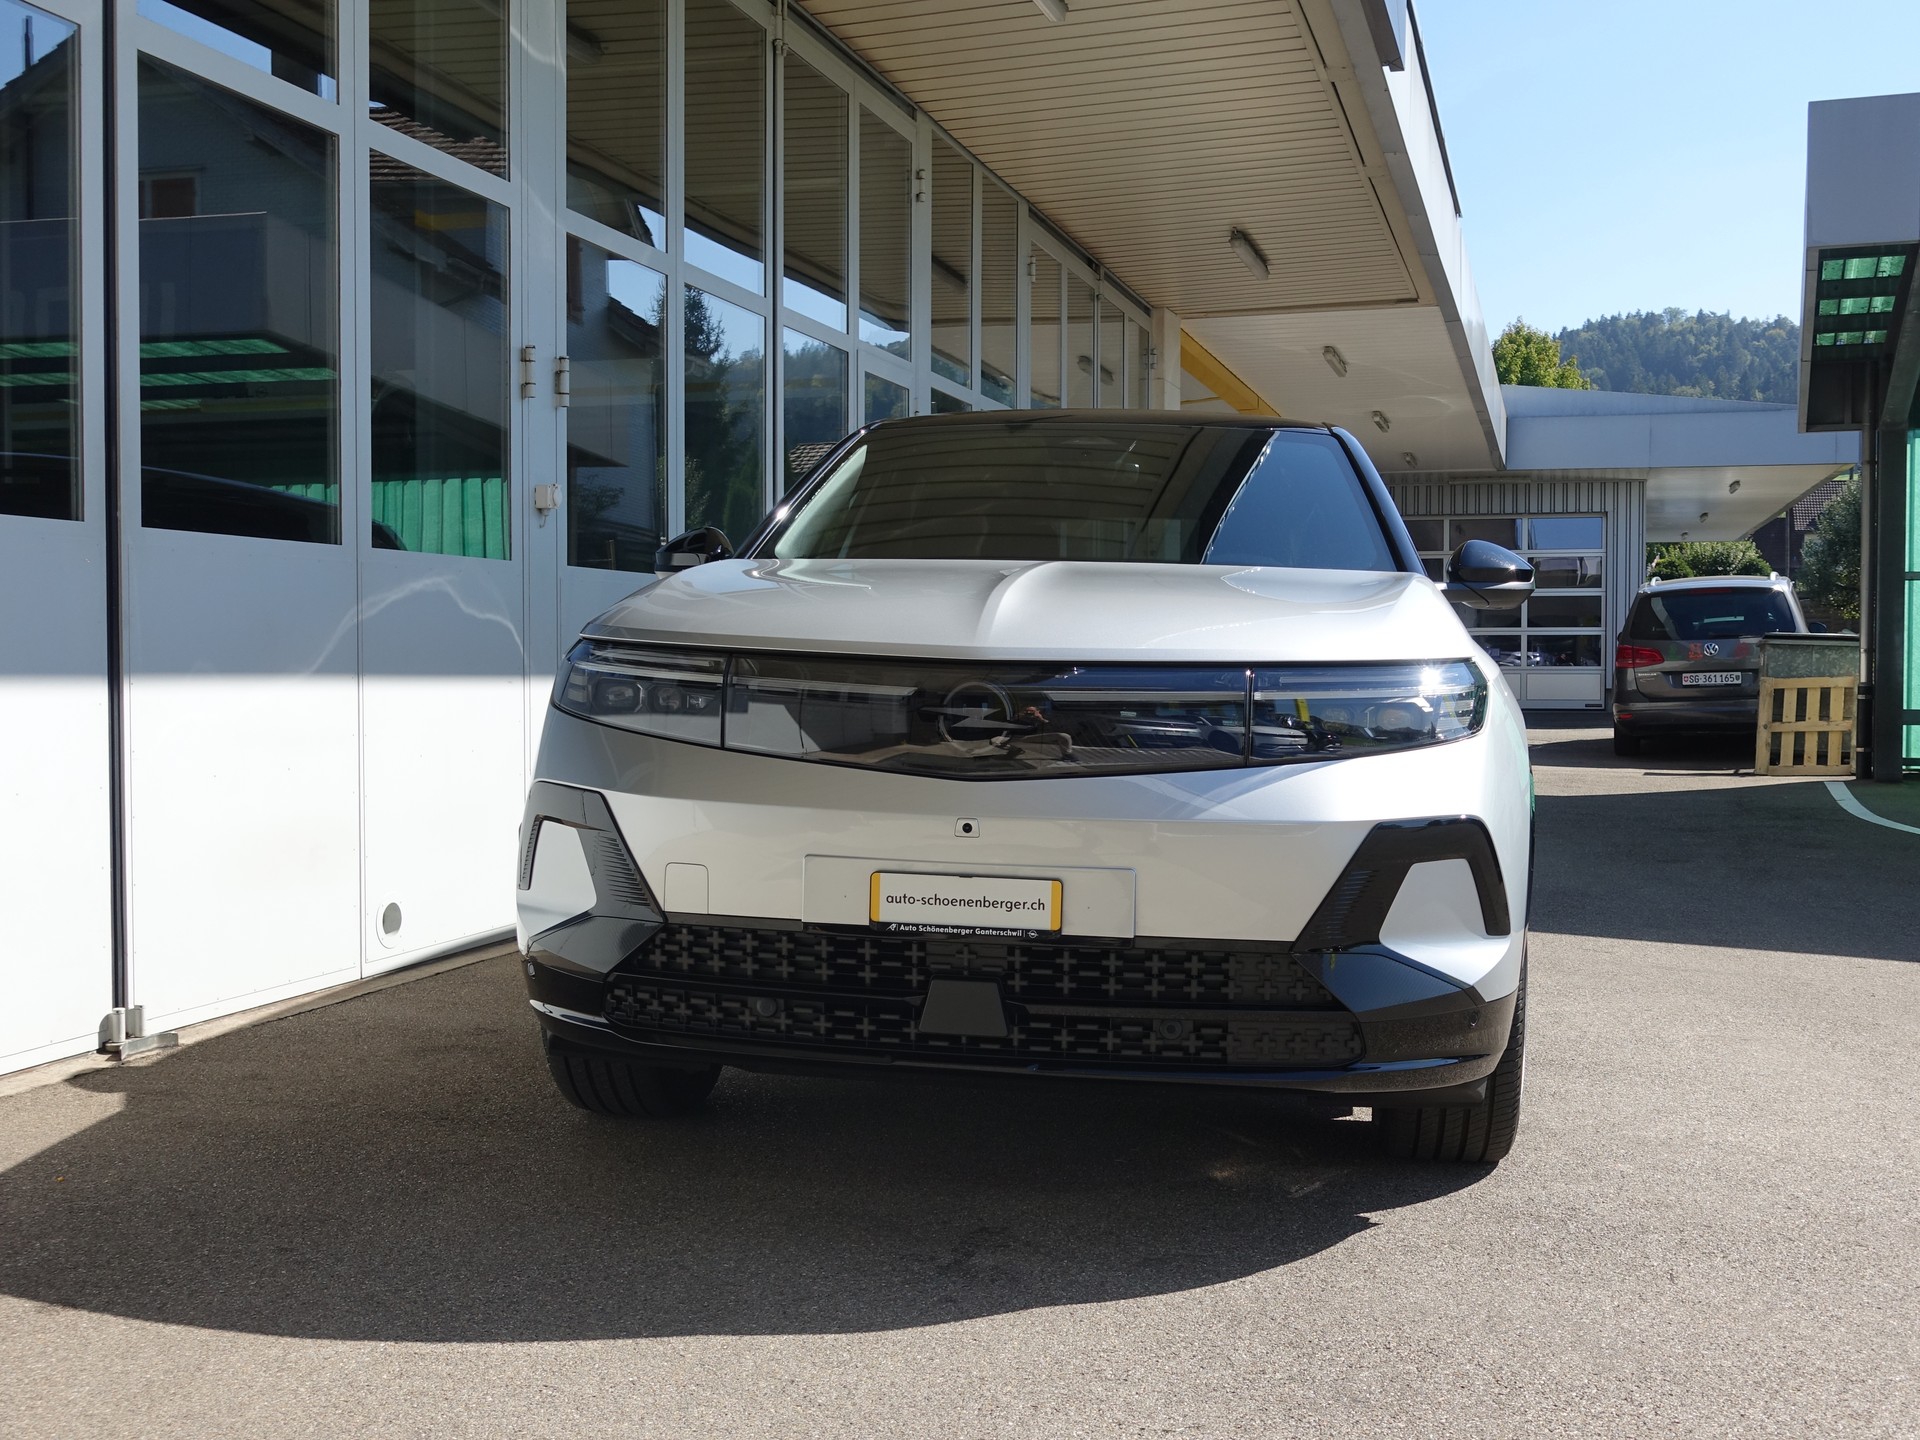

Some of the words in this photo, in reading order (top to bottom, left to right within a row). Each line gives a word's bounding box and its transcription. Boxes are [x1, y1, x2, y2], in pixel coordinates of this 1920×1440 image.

[886, 893, 1046, 912] auto-schoenenberger.ch
[899, 924, 917, 932] Auto
[918, 924, 974, 935] Schönenberger
[975, 928, 1022, 937] Ganterschwil
